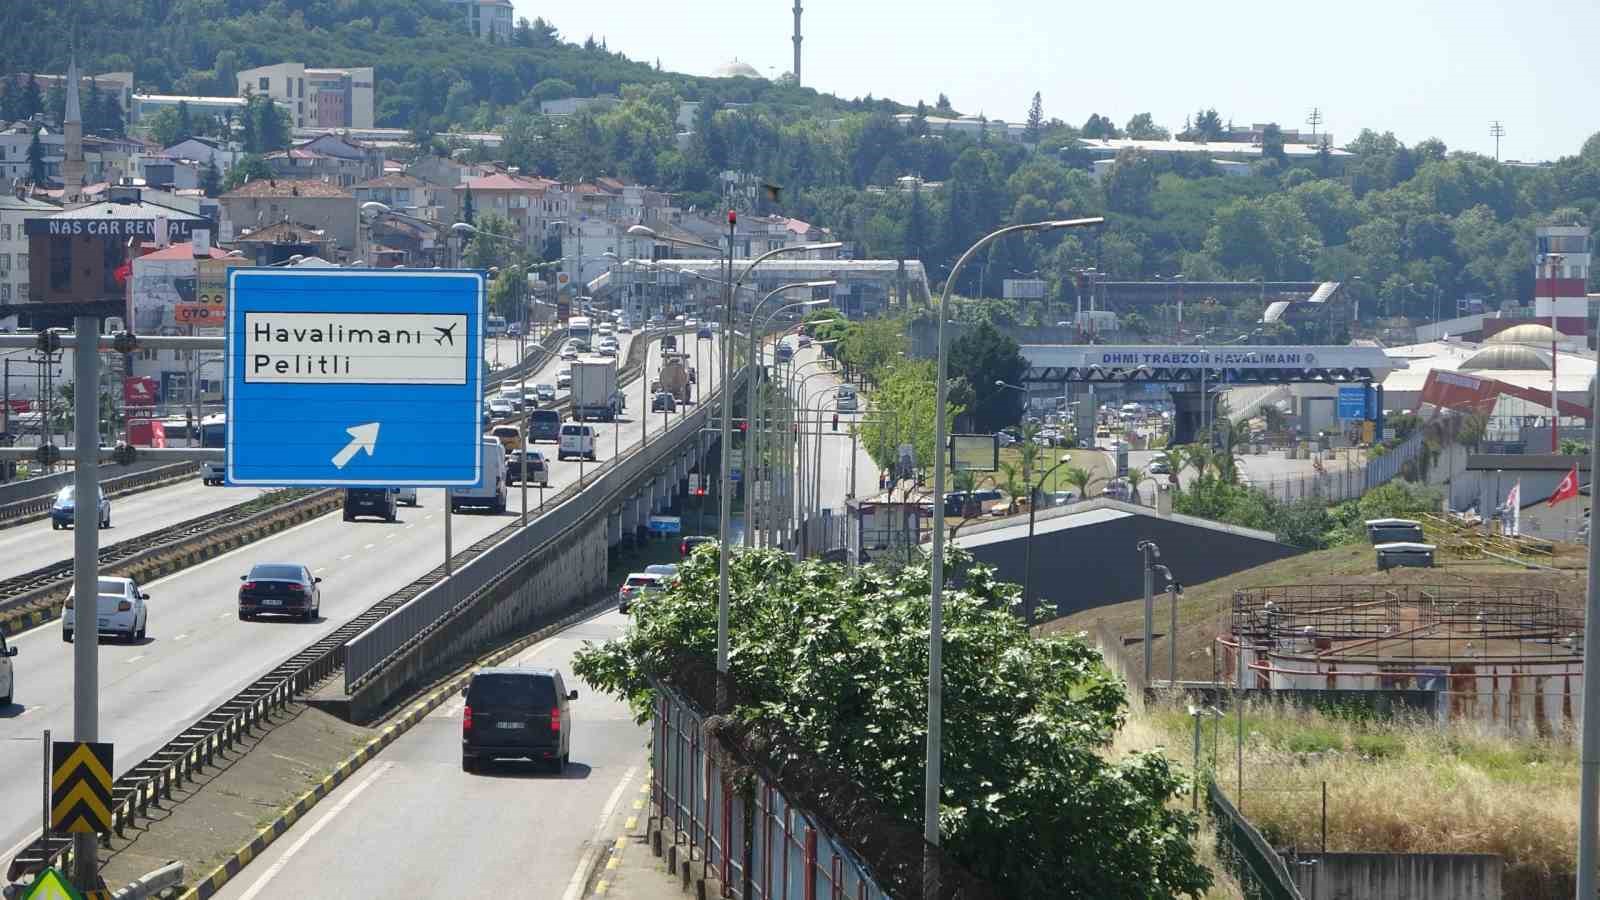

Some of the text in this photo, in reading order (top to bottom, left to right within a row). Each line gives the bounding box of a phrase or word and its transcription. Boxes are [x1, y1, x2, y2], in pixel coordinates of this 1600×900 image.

[50, 221, 189, 235] NAS CAR RENAL
[254, 322, 421, 344] Havalimanı
[254, 354, 350, 374] Pelitli
[1143, 353, 1210, 364] TRABZON
